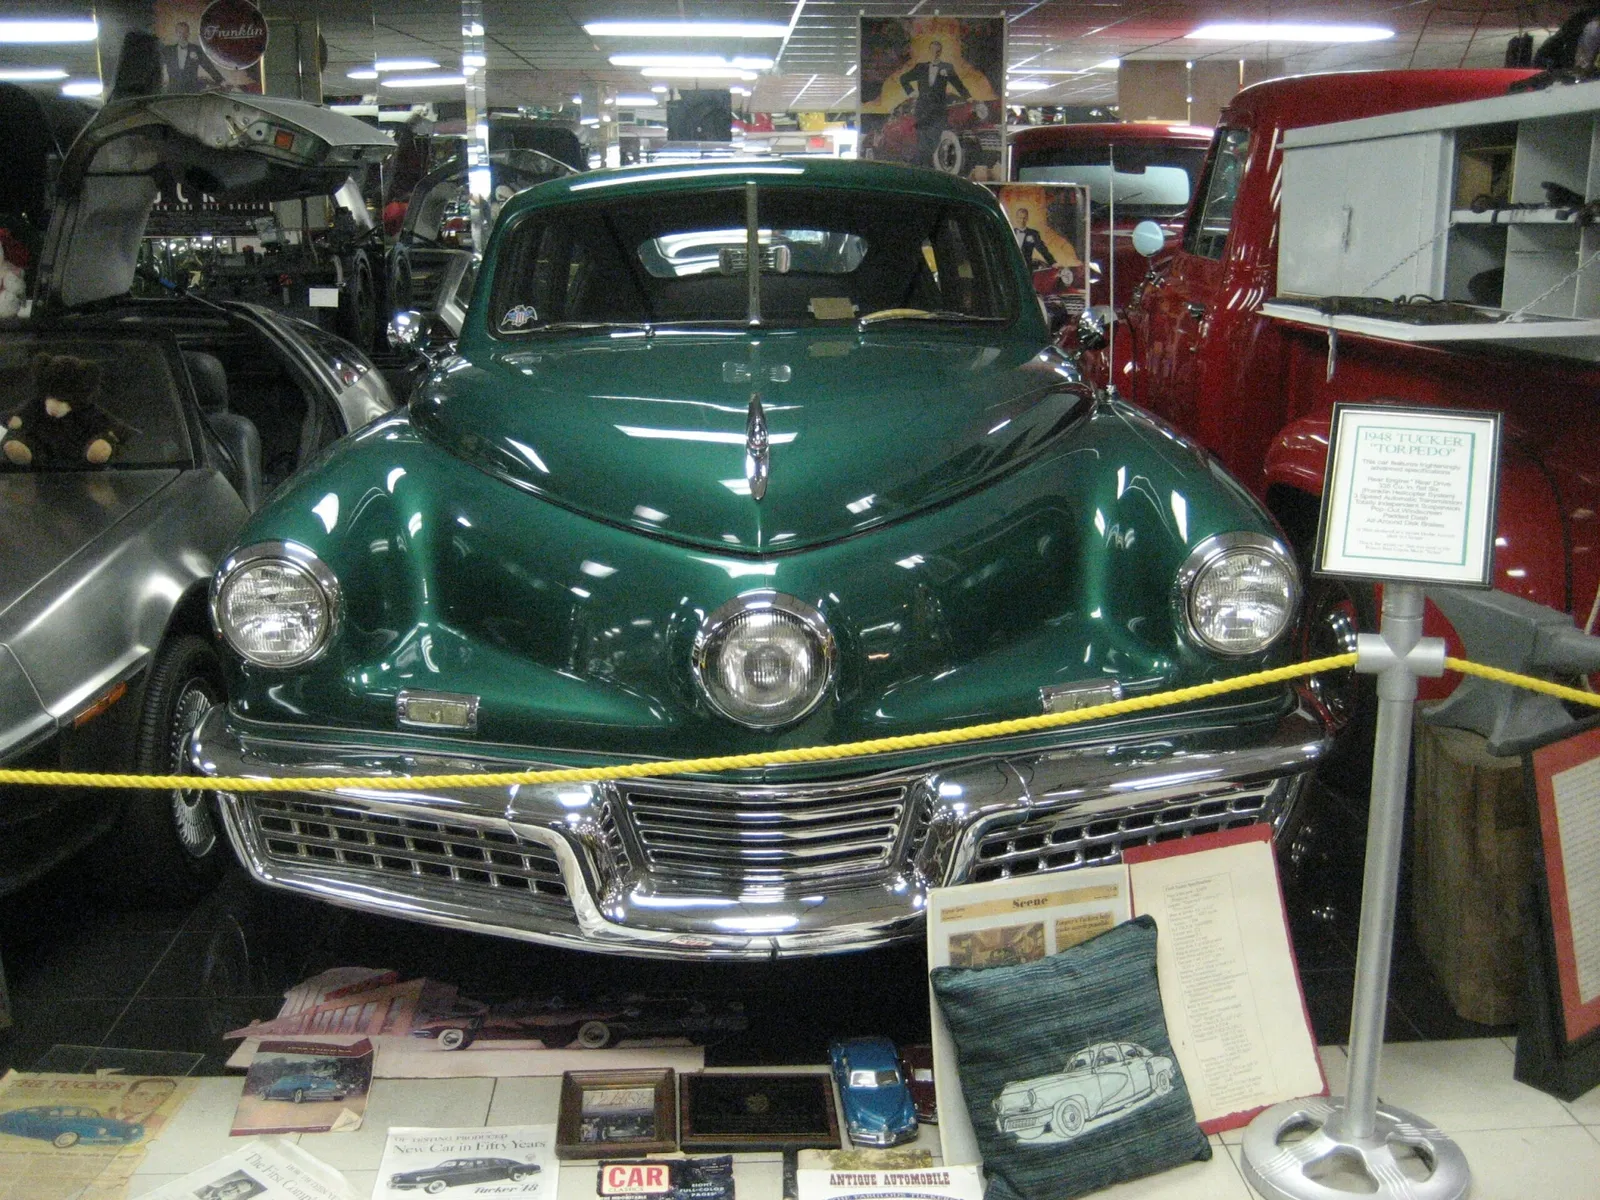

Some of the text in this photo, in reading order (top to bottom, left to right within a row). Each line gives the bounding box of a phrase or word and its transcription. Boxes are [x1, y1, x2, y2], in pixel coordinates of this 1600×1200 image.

[203, 24, 263, 40] Franklin
[1364, 431, 1464, 447] 1948 TUCKER
[1370, 443, 1456, 457] "TORPEDO"
[1012, 896, 1049, 909] Scene
[393, 1139, 548, 1154] New Car in Fifty Years
[244, 1151, 265, 1169] The
[261, 1163, 285, 1183] First
[608, 1166, 663, 1188] CAR
[829, 1172, 950, 1186] ANTIQUE AUTOMOBILE
[474, 1186, 517, 1195] Tucker
